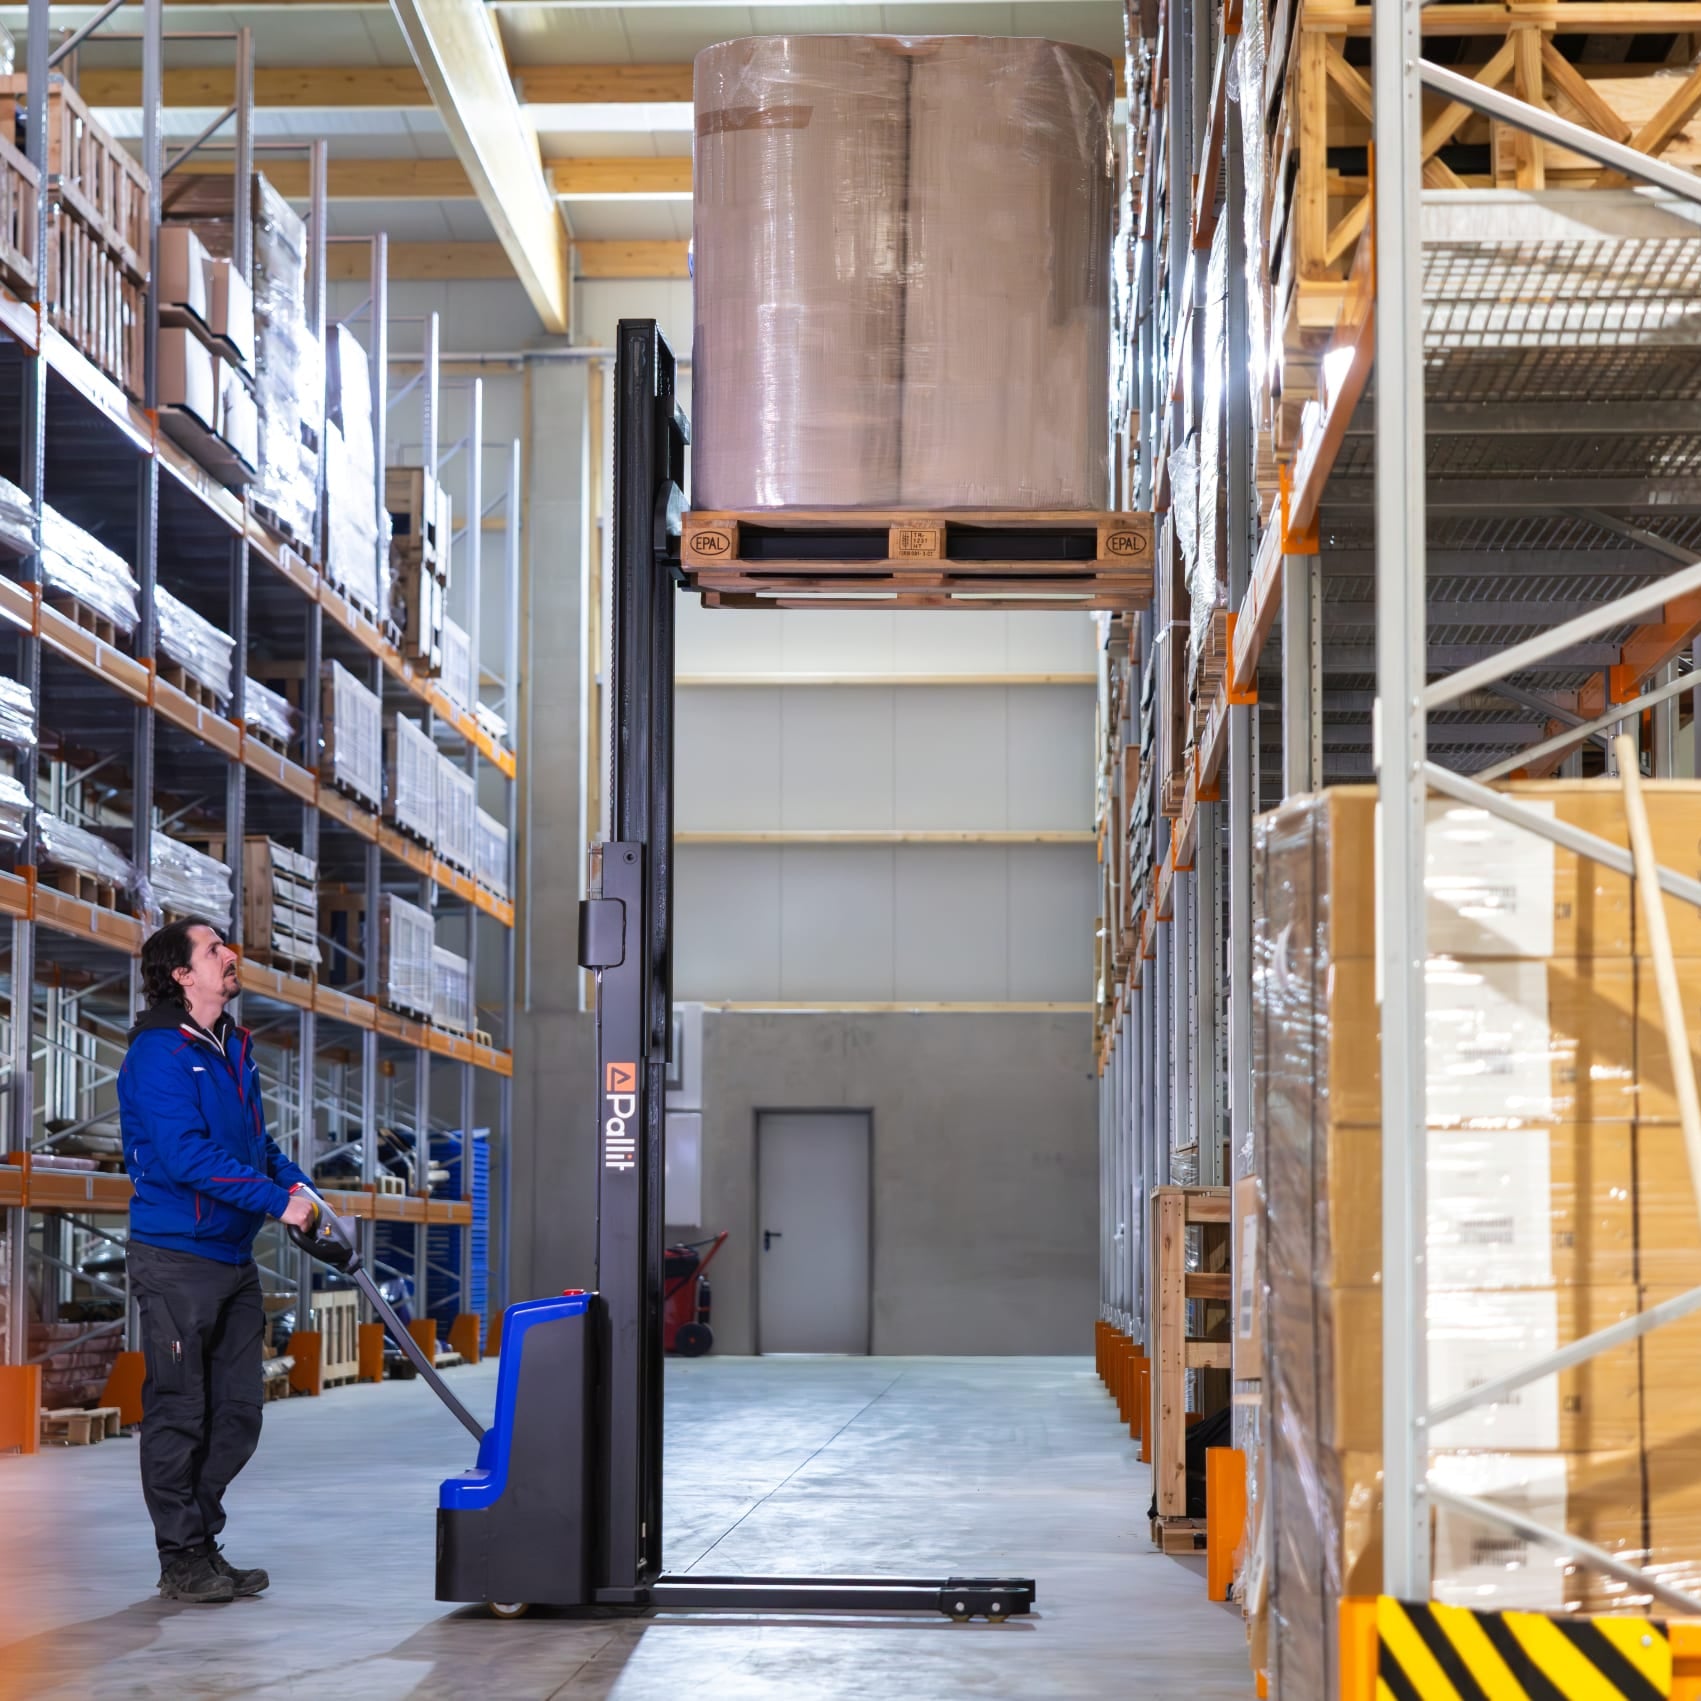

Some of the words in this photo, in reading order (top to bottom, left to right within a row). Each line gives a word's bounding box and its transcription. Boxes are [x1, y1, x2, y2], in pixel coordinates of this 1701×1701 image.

[695, 536, 724, 551] EPAL
[1111, 536, 1140, 551] EPAL
[605, 1094, 636, 1171] Pallit
